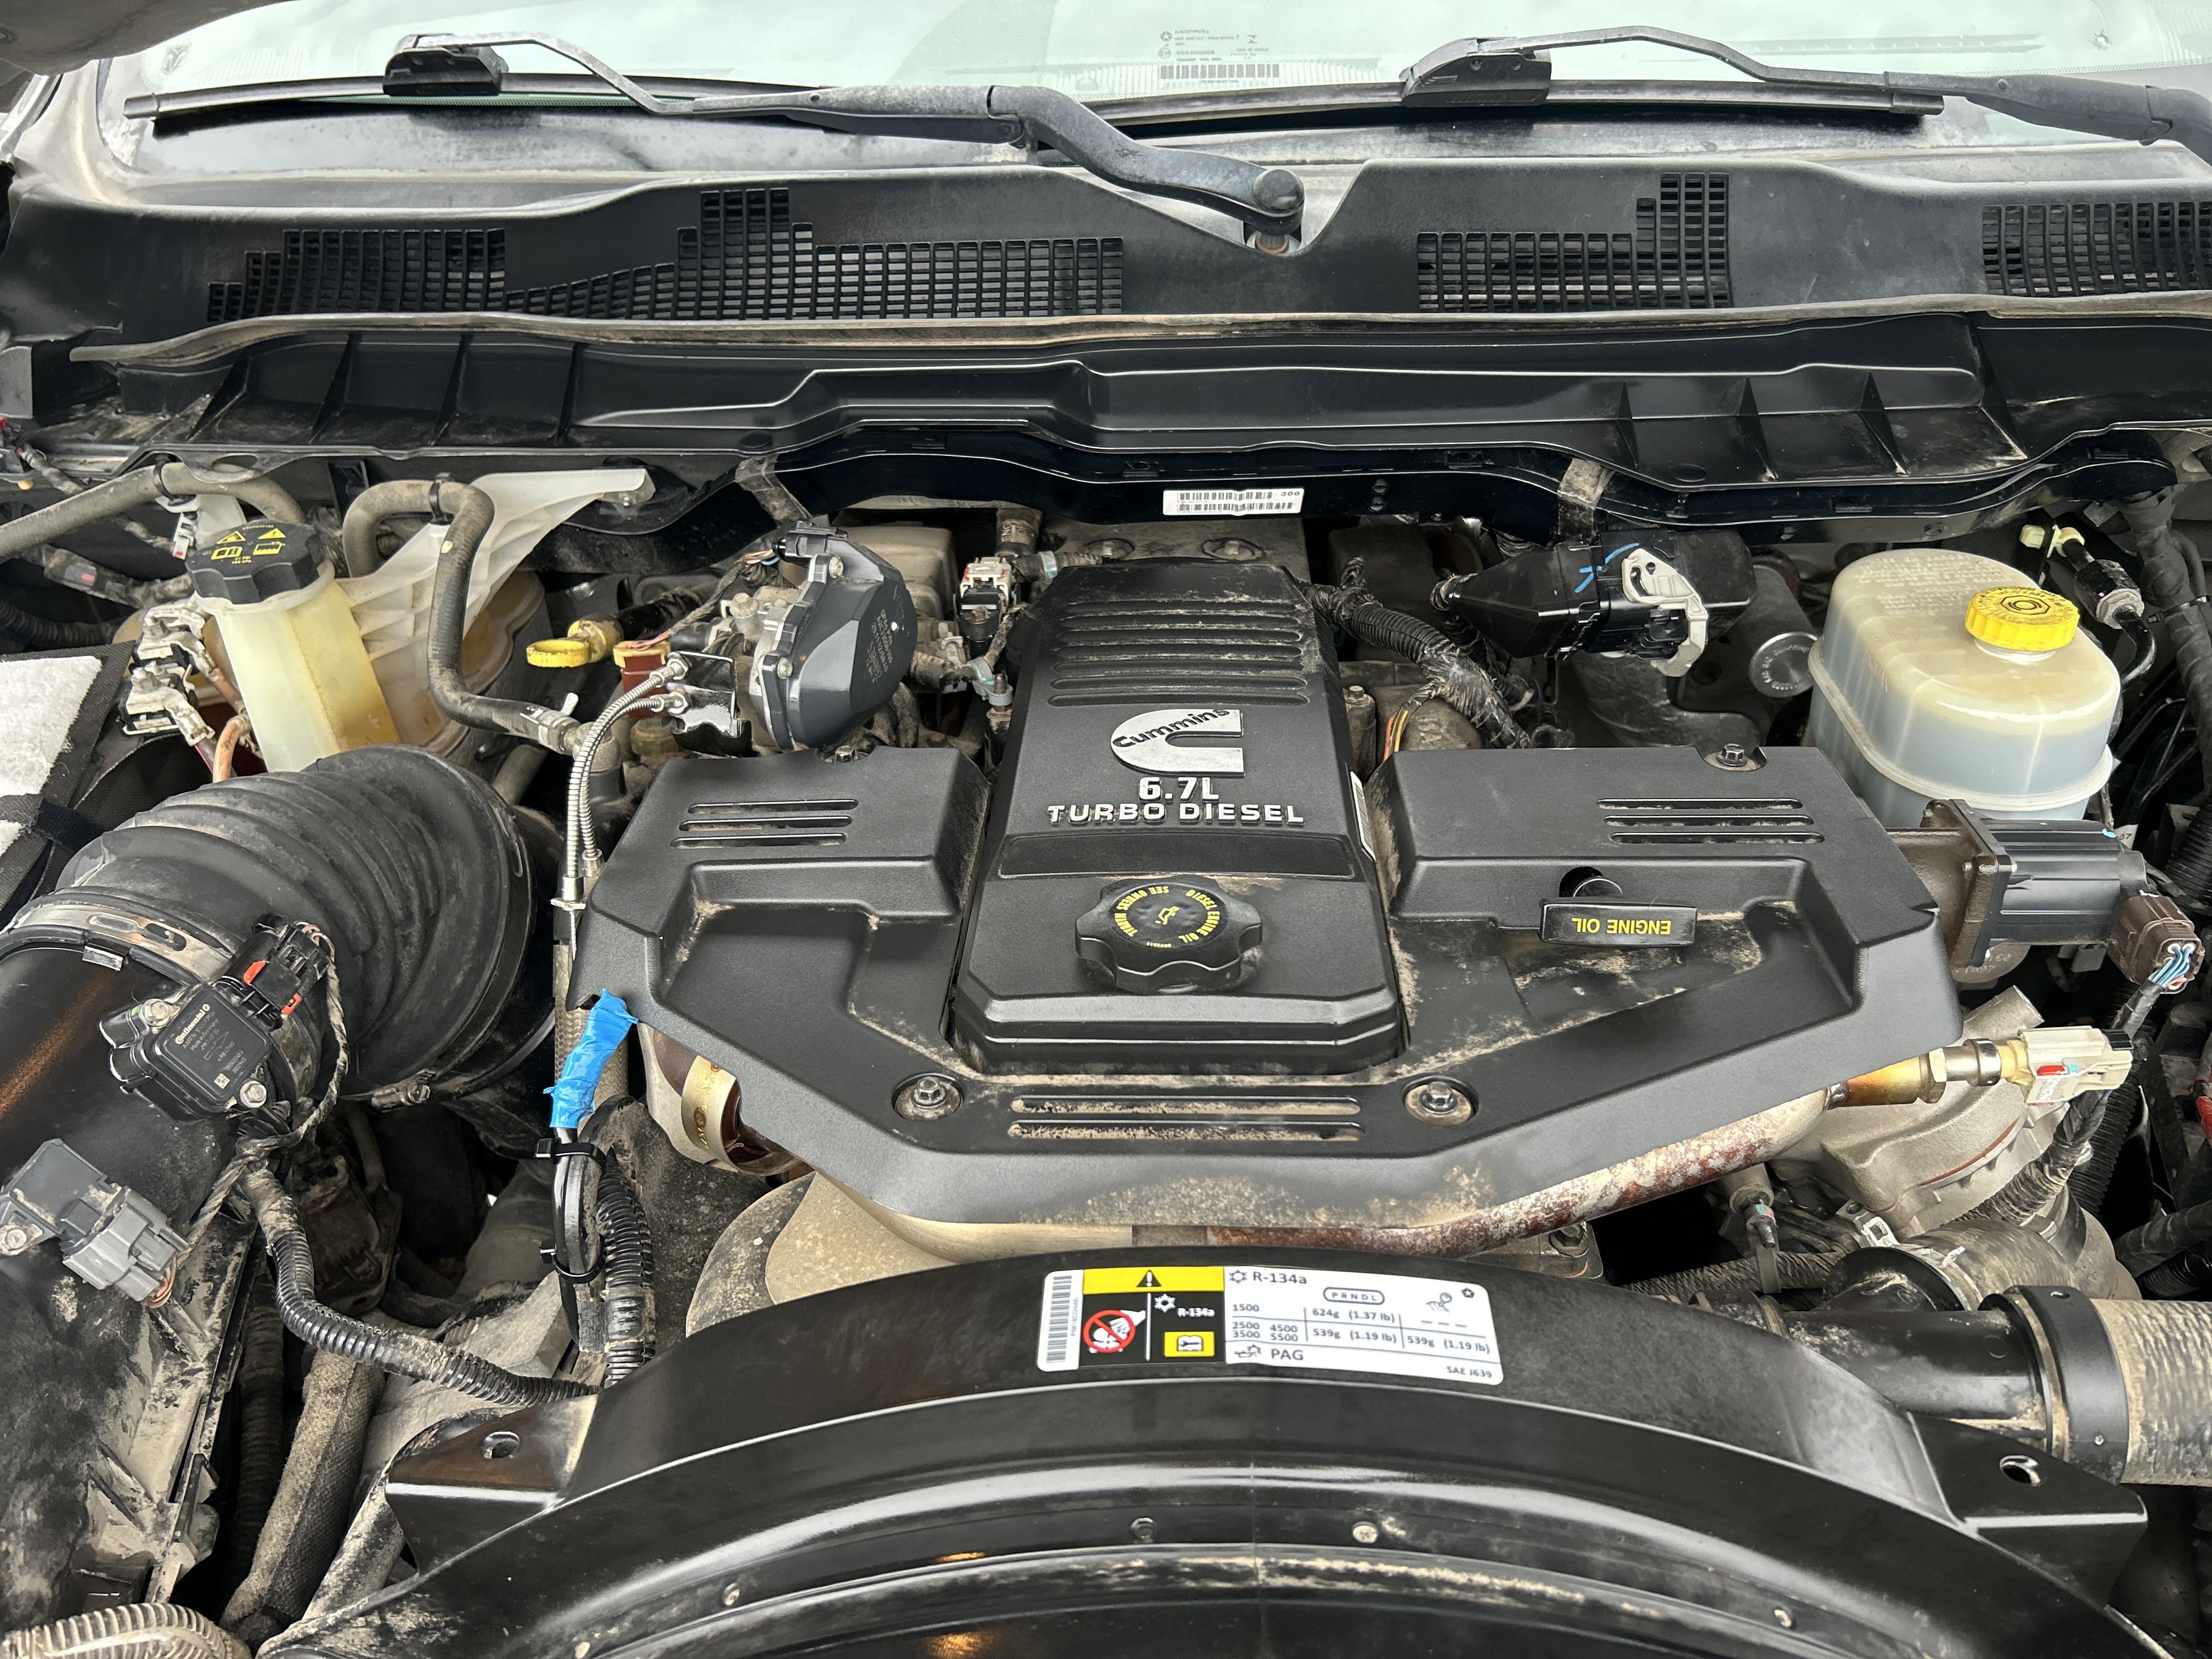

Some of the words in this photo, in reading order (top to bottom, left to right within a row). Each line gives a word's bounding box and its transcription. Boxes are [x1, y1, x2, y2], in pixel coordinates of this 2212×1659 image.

[1112, 708, 1231, 749] Cummins
[1139, 777, 1220, 802] 6.7L
[1048, 803, 1166, 826] TURBO
[1180, 803, 1306, 826] DIESEL
[1148, 886, 1169, 895] SEE
[1186, 889, 1217, 910] DIESEL
[1114, 912, 1138, 937] MANUAL
[1197, 911, 1221, 936] ENGINE
[1571, 917, 1600, 934] OIL
[1606, 918, 1672, 935] ENGINE
[1178, 933, 1200, 943] OIL
[175, 1009, 206, 1045] Continental
[1252, 1271, 1307, 1285] R-134a
[1178, 1307, 1216, 1318] R-134a
[1232, 1304, 1260, 1312] 1500
[1312, 1308, 1340, 1319] 624g
[1348, 1310, 1377, 1320] (1.37
[1380, 1313, 1396, 1323] lb)
[1232, 1322, 1260, 1330] 2500
[1269, 1324, 1298, 1333] 4500
[1232, 1330, 1261, 1339] 3500
[1270, 1333, 1299, 1342] 5500
[1313, 1329, 1341, 1339] 539g
[1350, 1330, 1379, 1341] (1.19
[1381, 1333, 1397, 1344] lb)
[1407, 1335, 1436, 1347] 539g
[1443, 1339, 1472, 1351] (1.19
[1475, 1342, 1491, 1355] lb)
[1271, 1348, 1304, 1361] PAG
[1447, 1365, 1466, 1376] SAE
[1469, 1368, 1492, 1378] J639
